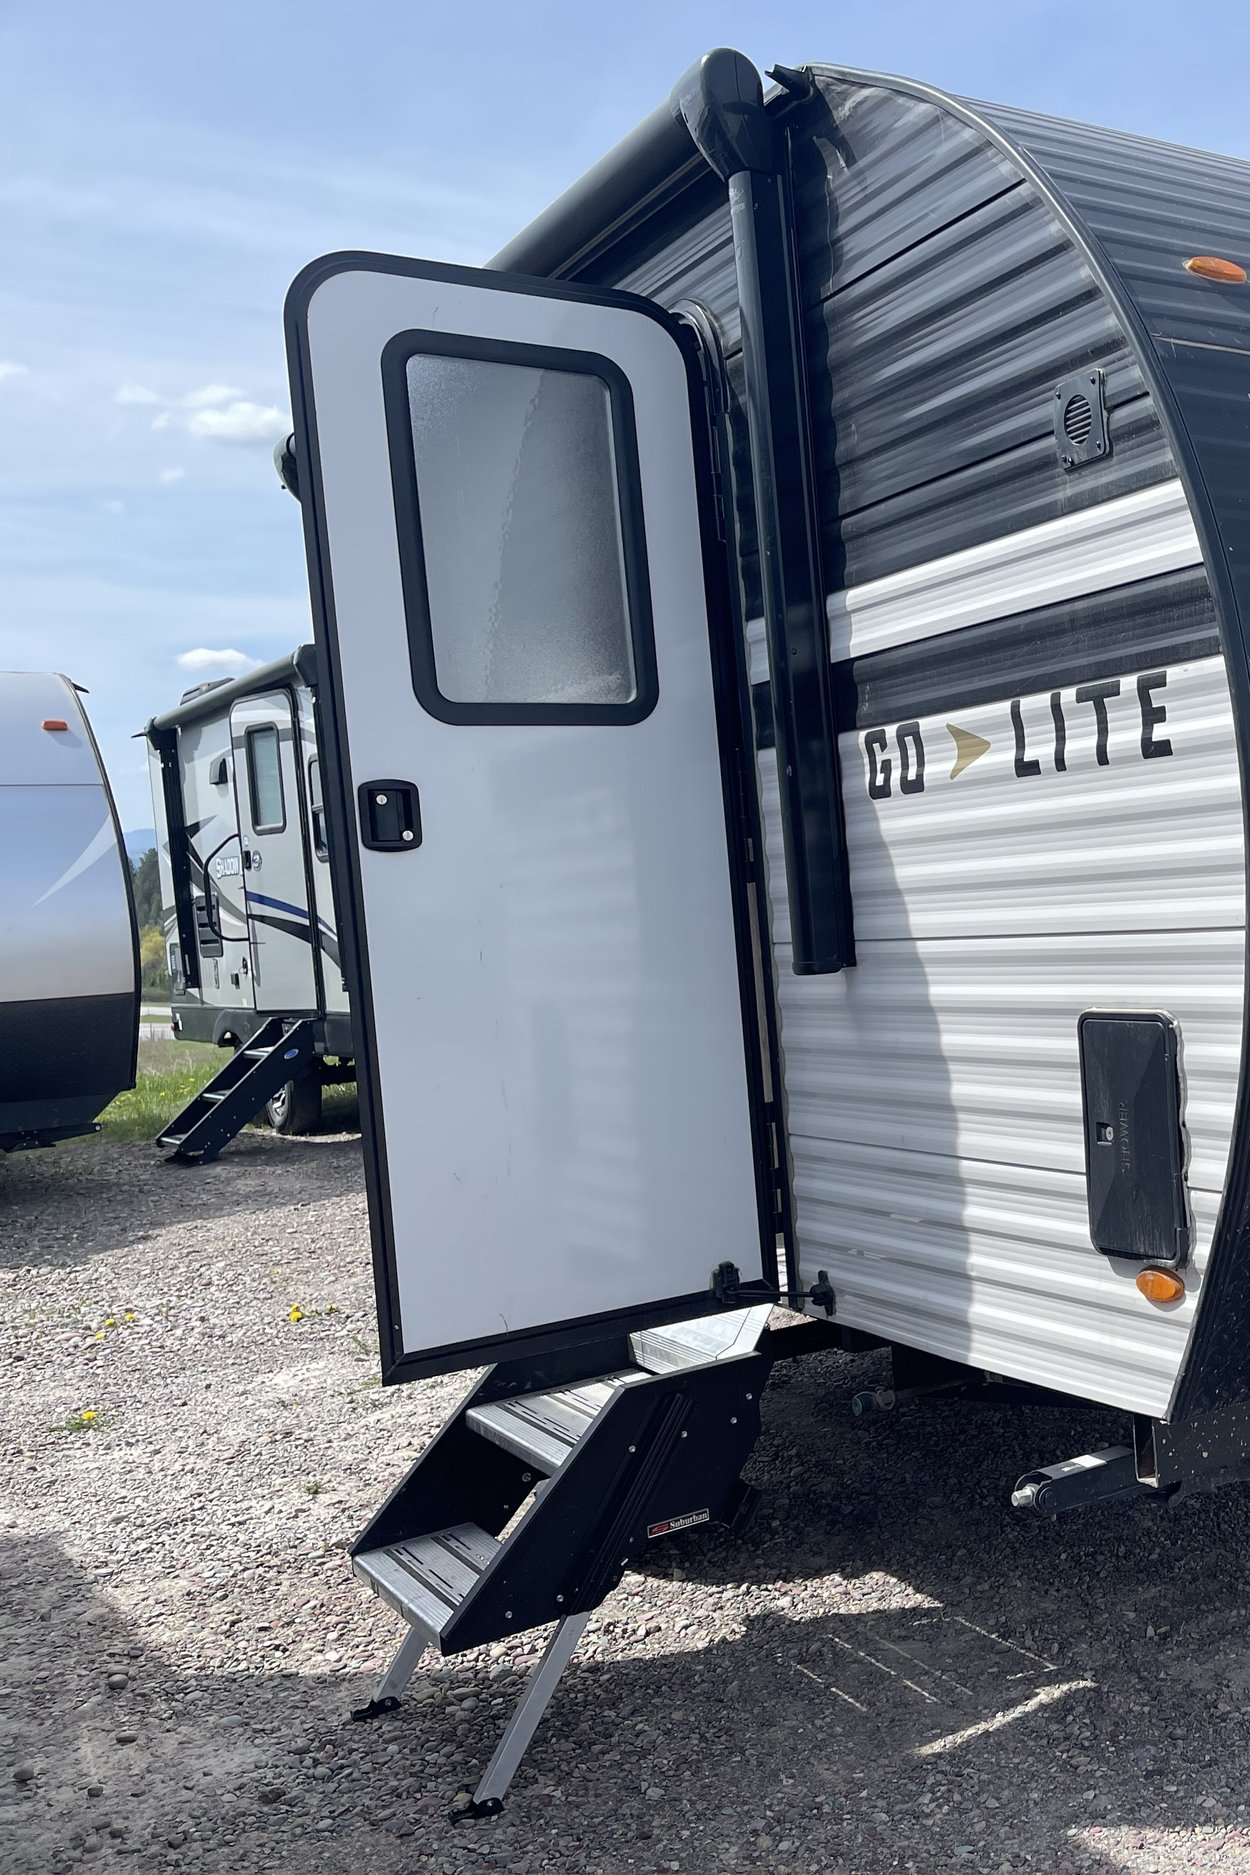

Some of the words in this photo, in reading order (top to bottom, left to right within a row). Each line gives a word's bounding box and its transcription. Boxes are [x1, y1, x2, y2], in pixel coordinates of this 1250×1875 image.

[864, 720, 926, 800] GO
[1010, 670, 1174, 778] LITE
[1120, 1102, 1130, 1173] SHOWER
[669, 1512, 707, 1528] Suburban
